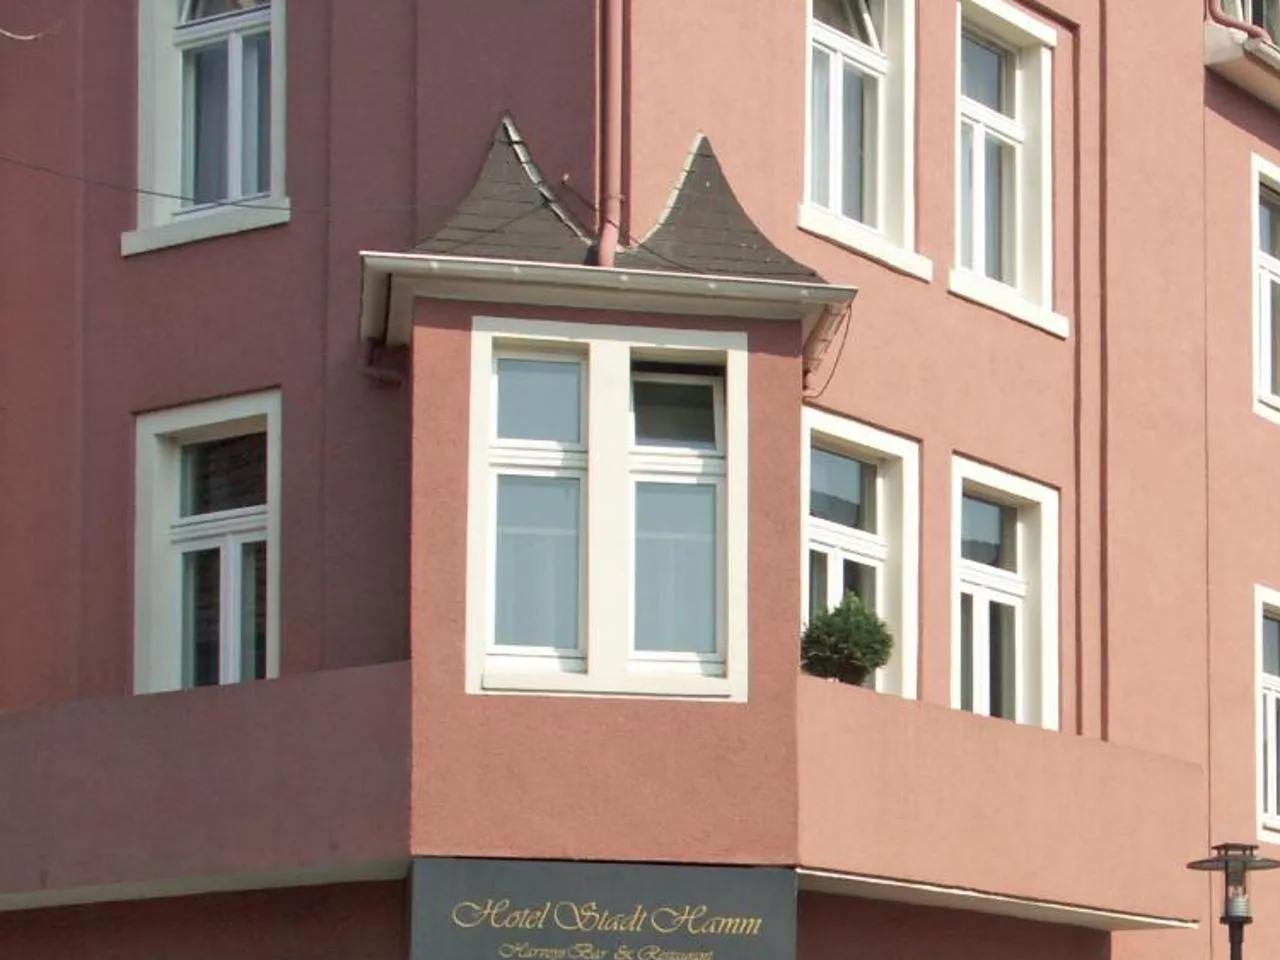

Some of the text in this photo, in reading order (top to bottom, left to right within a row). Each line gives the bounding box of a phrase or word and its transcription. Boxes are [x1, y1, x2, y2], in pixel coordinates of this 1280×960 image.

[452, 898, 763, 935] Hotel Stadt Hamm
[568, 943, 608, 960] Bar
